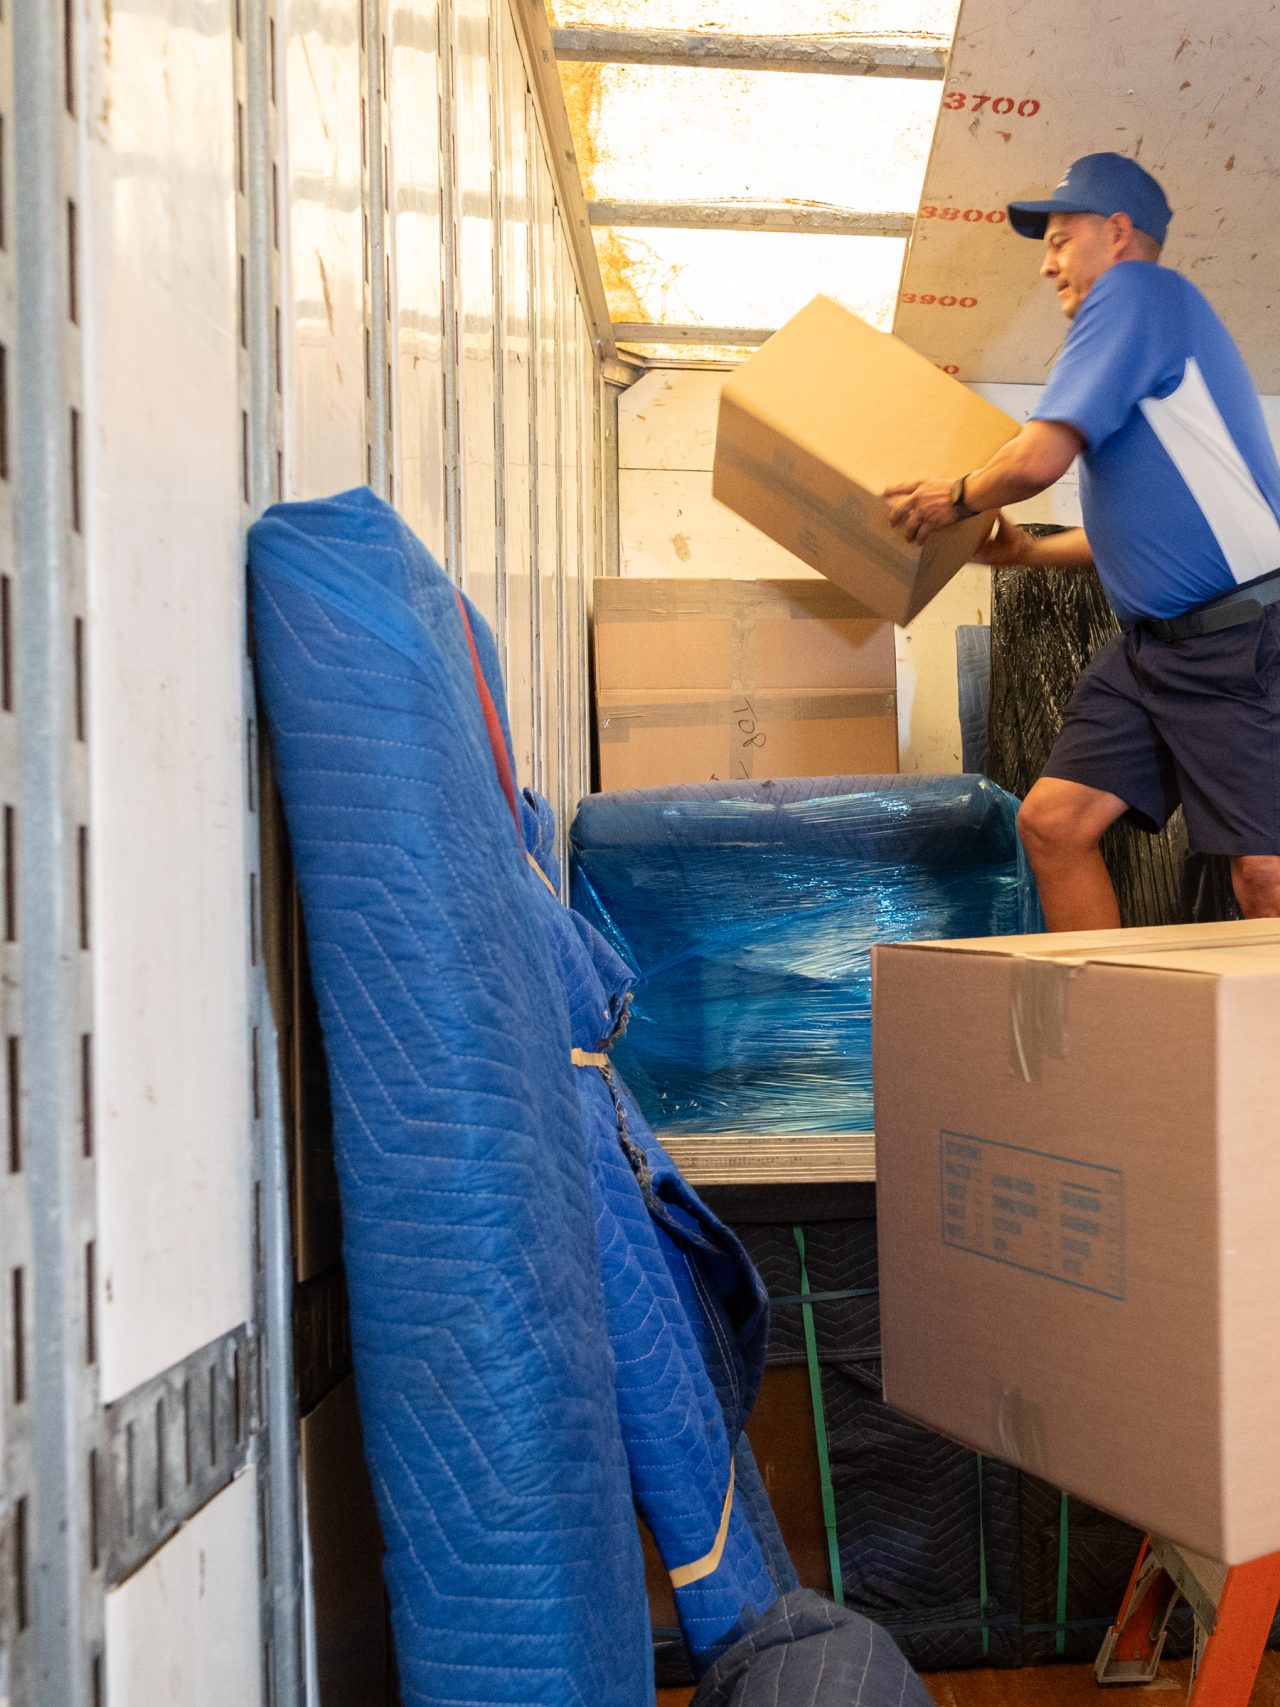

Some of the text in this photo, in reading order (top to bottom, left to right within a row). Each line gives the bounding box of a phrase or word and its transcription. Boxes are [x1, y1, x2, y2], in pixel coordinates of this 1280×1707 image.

[943, 91, 1041, 117] 3700
[918, 205, 1007, 224] 3800
[901, 293, 978, 308] 3900
